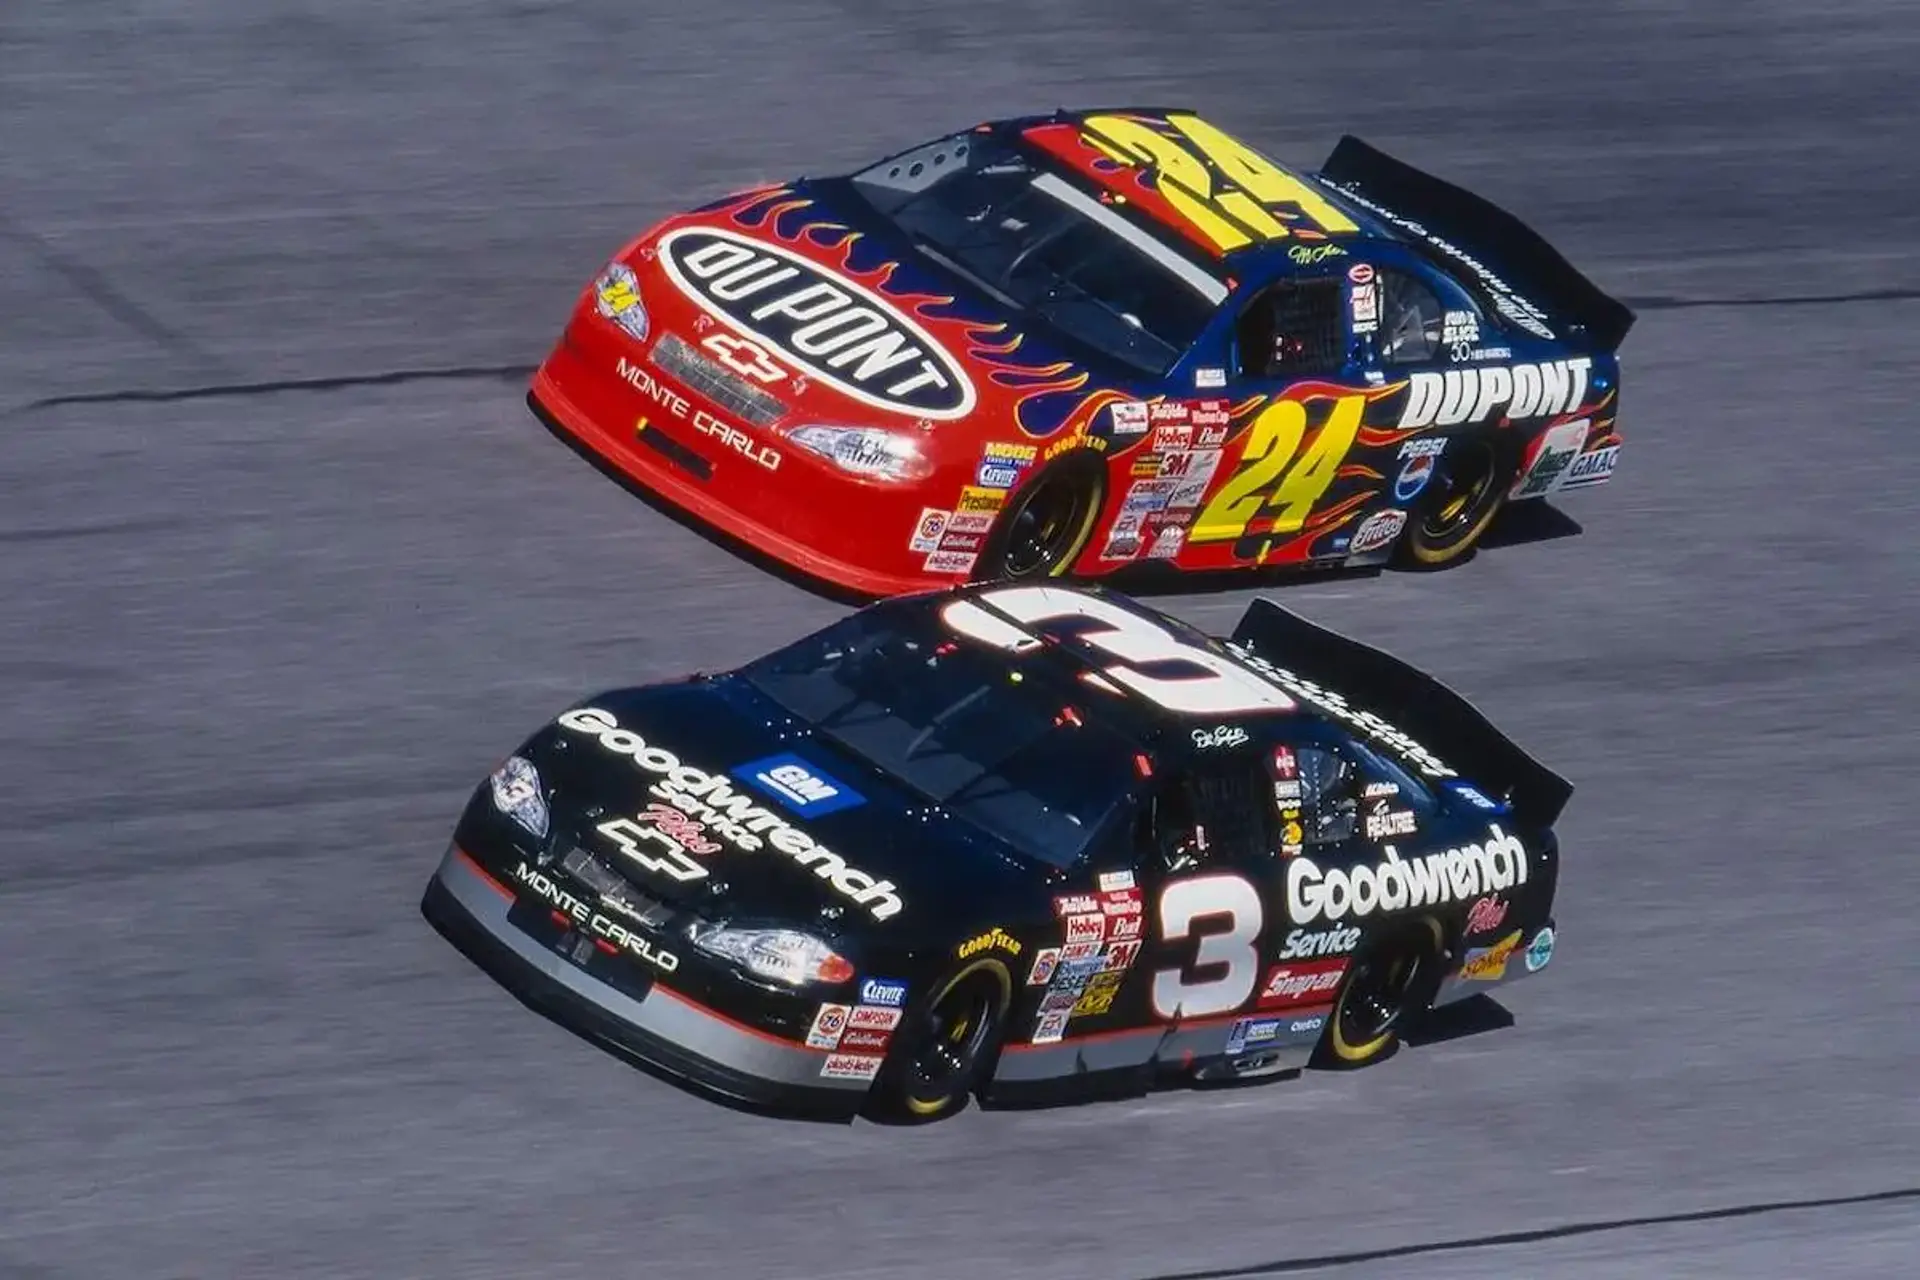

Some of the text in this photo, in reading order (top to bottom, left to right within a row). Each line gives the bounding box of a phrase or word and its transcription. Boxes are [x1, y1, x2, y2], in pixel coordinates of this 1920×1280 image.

[1083, 114, 1361, 251] 24
[615, 356, 781, 471] MONTE CARLO
[1397, 357, 1592, 429] DUPONT
[985, 442, 1038, 460] MOOG
[1160, 453, 1193, 476] 3M
[1189, 395, 1367, 542] 24
[1397, 437, 1449, 460] PEPSI
[939, 586, 1299, 713] 3
[768, 764, 840, 802] GM
[558, 707, 905, 923] Goodwrench
[649, 779, 764, 853] Service
[1287, 825, 1529, 925] Goodwrench
[515, 862, 680, 973] MONTE CARLO
[958, 927, 1022, 959] GOODYEAR
[1278, 921, 1362, 960] Service
[1151, 875, 1263, 1019] 3
[862, 979, 905, 1000] CLEVITE
[1261, 969, 1344, 1000] Snap-on
[824, 1013, 841, 1027] 76
[852, 1009, 897, 1026] SIMPSON
